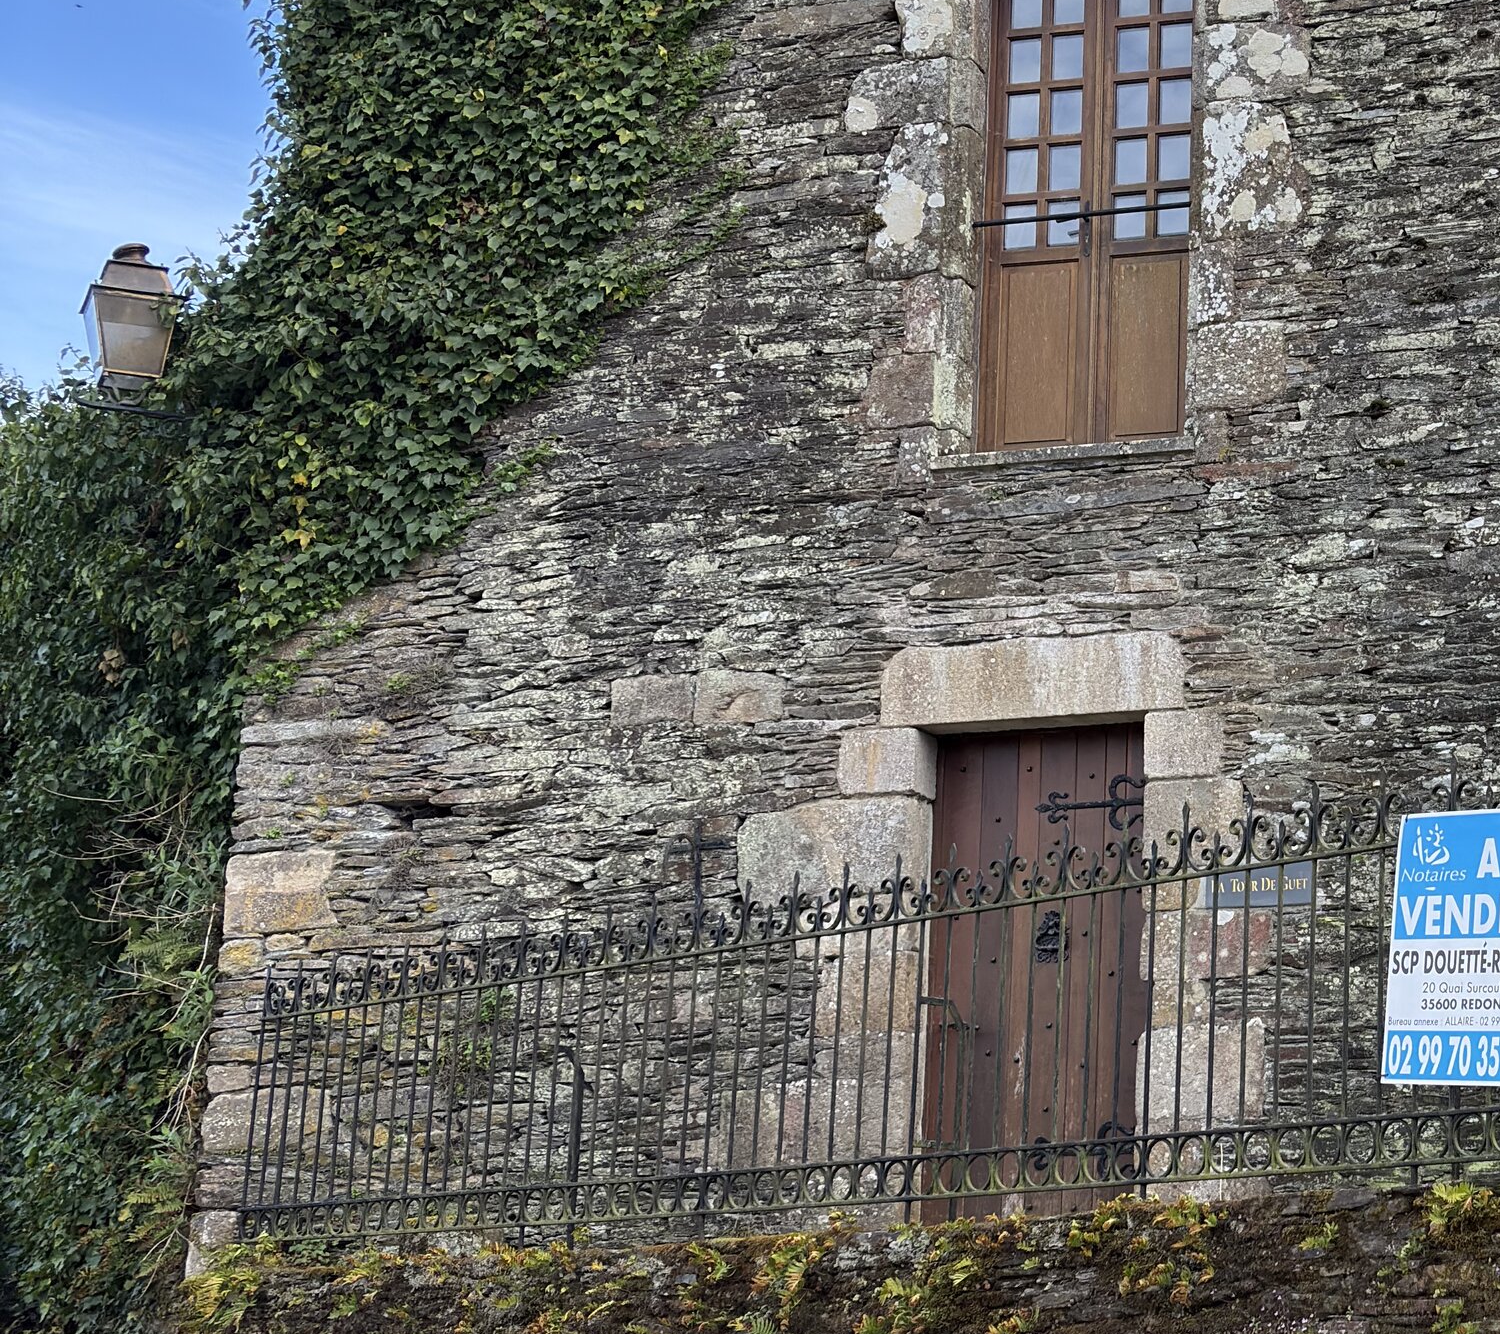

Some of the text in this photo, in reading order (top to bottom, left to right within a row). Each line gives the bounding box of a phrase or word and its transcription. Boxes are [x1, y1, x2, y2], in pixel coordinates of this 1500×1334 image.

[1476, 837, 1500, 879] A
[1401, 867, 1467, 883] Notaires
[1230, 878, 1258, 893] TOR
[1392, 950, 1419, 975] SCP
[1422, 982, 1436, 994] 20
[1439, 982, 1463, 994] Quai
[1420, 998, 1457, 1010] 35600
[1388, 1016, 1412, 1026] Bureau
[1444, 1016, 1474, 1026] ALLAIRE
[1480, 1016, 1489, 1026] 02
[1491, 1016, 1500, 1026] 99
[1388, 1034, 1413, 1075] 02
[1418, 1034, 1443, 1075] 99
[1446, 1035, 1472, 1077] 70
[1476, 1035, 1500, 1077] 35
